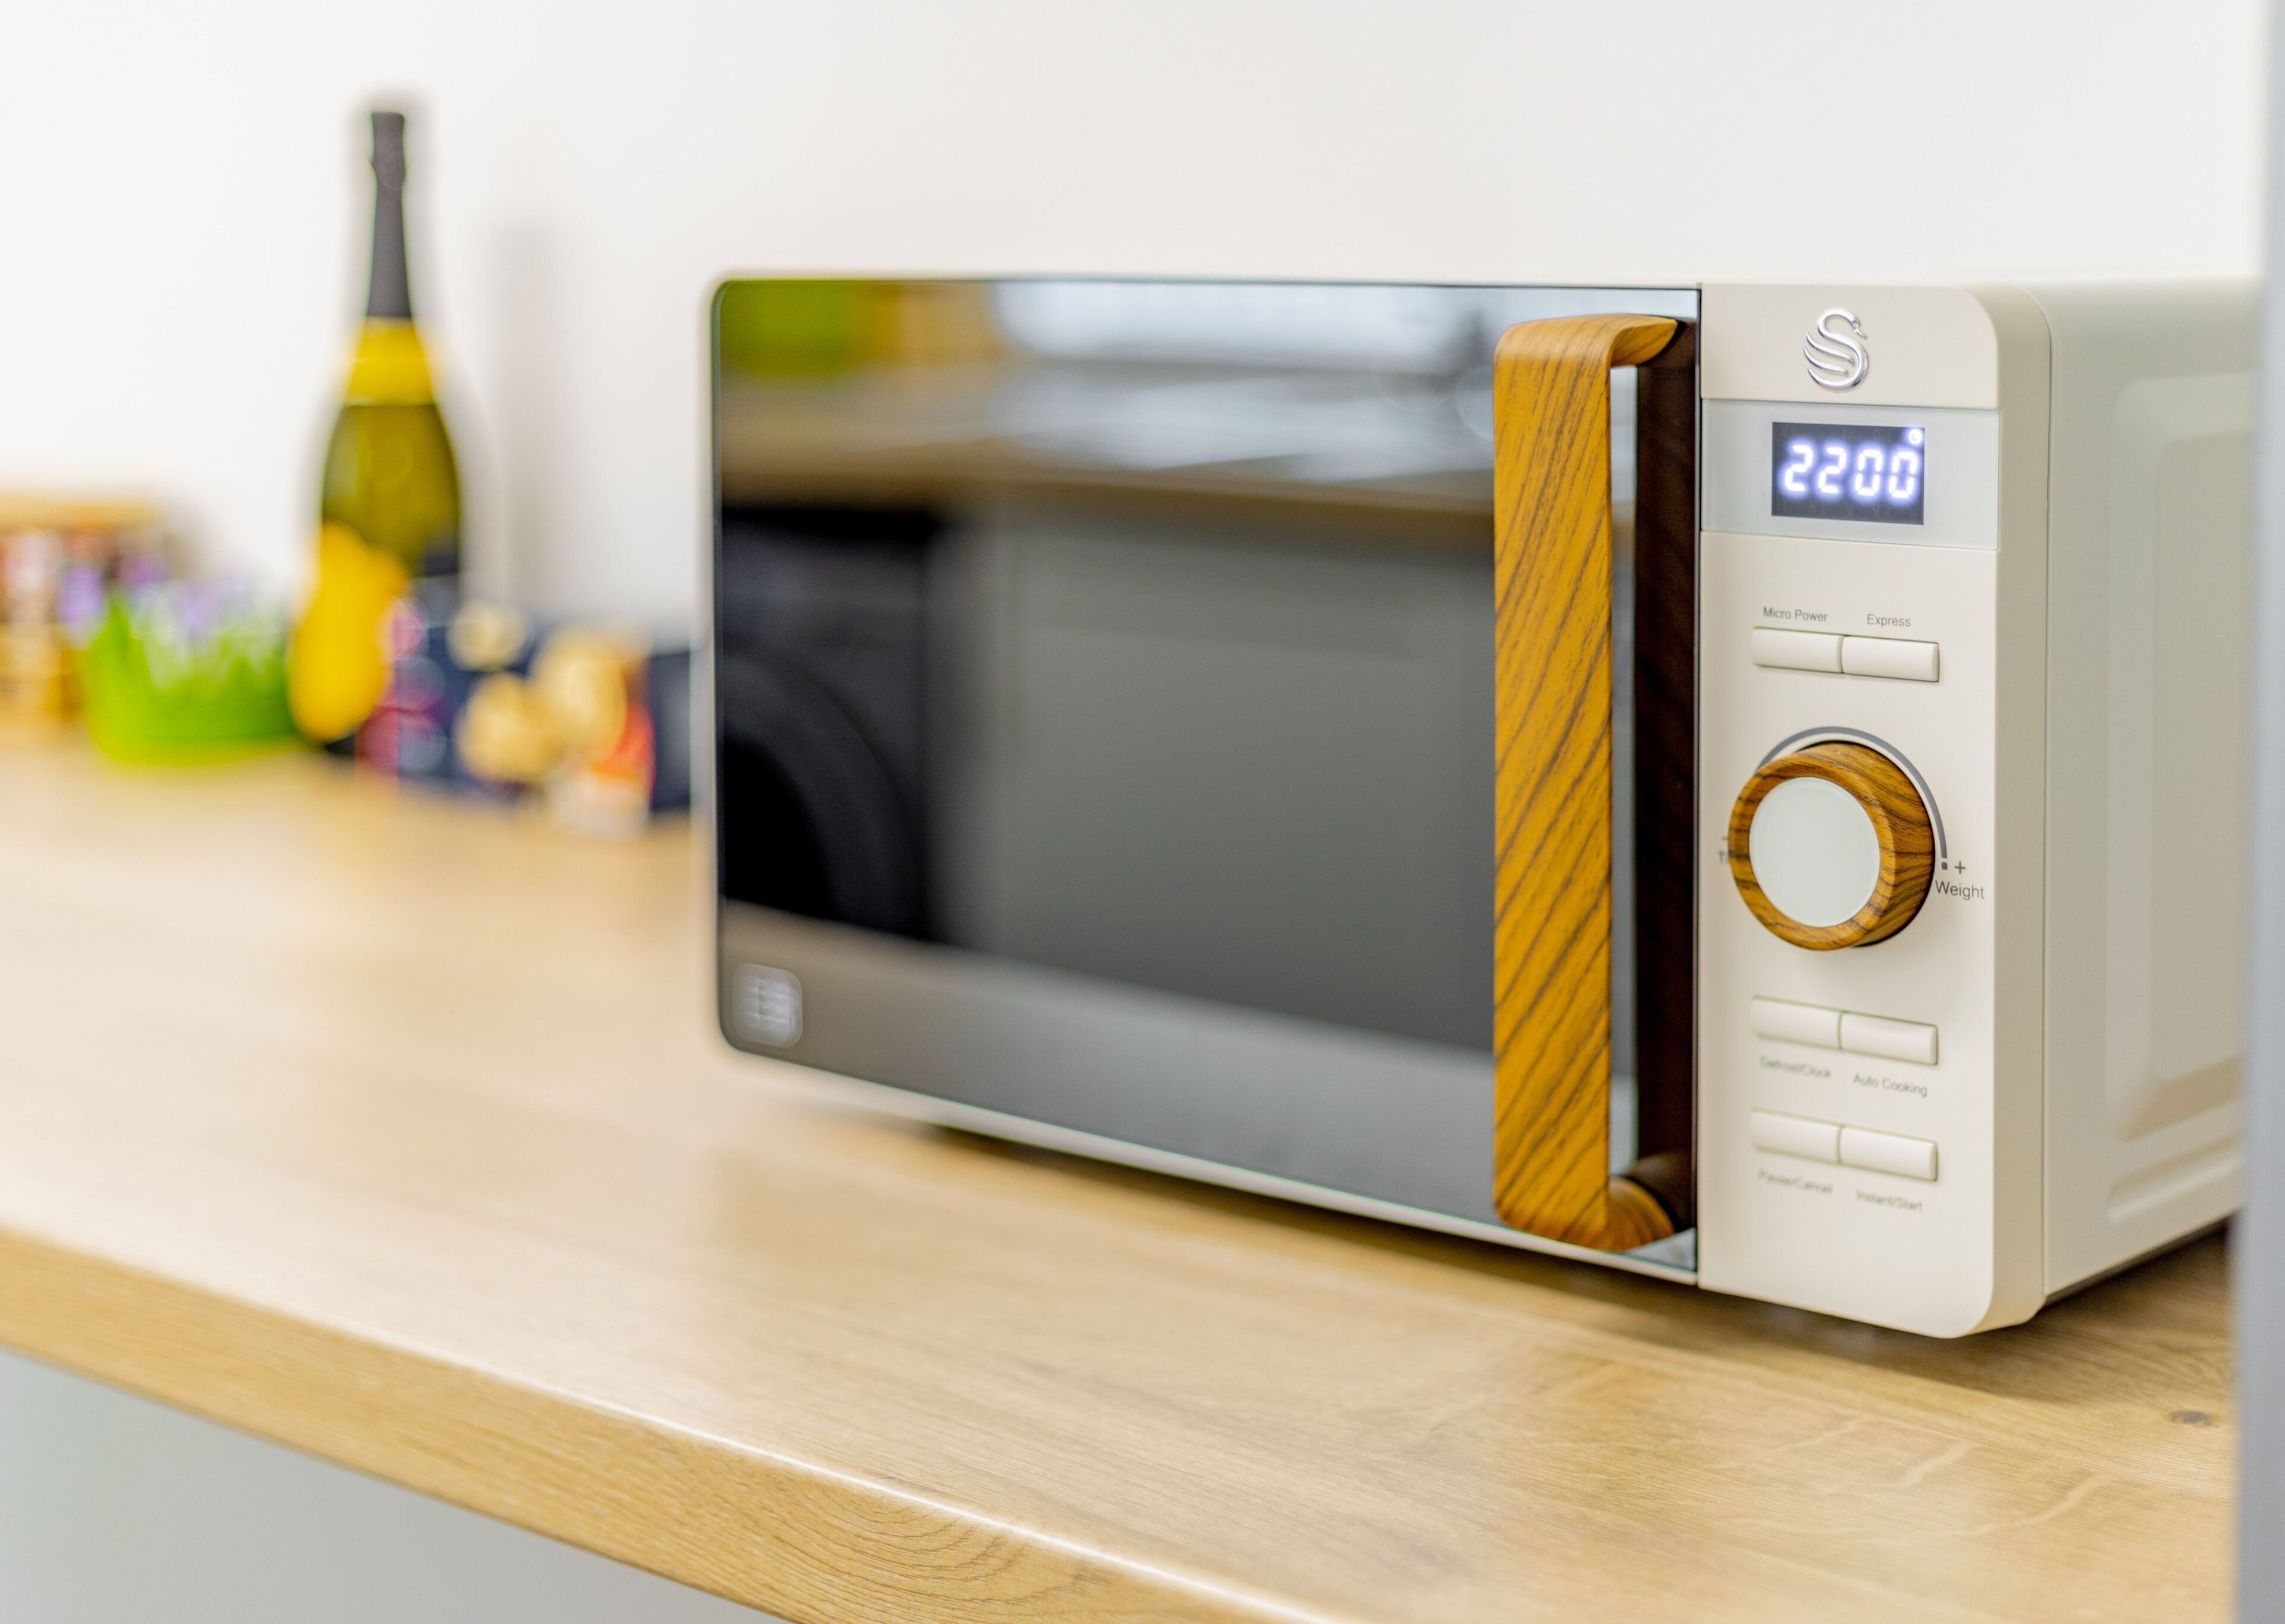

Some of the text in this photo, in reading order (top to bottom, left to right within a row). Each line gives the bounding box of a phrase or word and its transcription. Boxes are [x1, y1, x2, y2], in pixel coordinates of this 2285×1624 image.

[1784, 444, 1918, 499] 2200
[1763, 607, 1828, 622] Micro Power
[1867, 613, 1911, 628] Express
[1935, 880, 1985, 901] Weight
[1852, 1073, 1928, 1099] Auto Cooking
